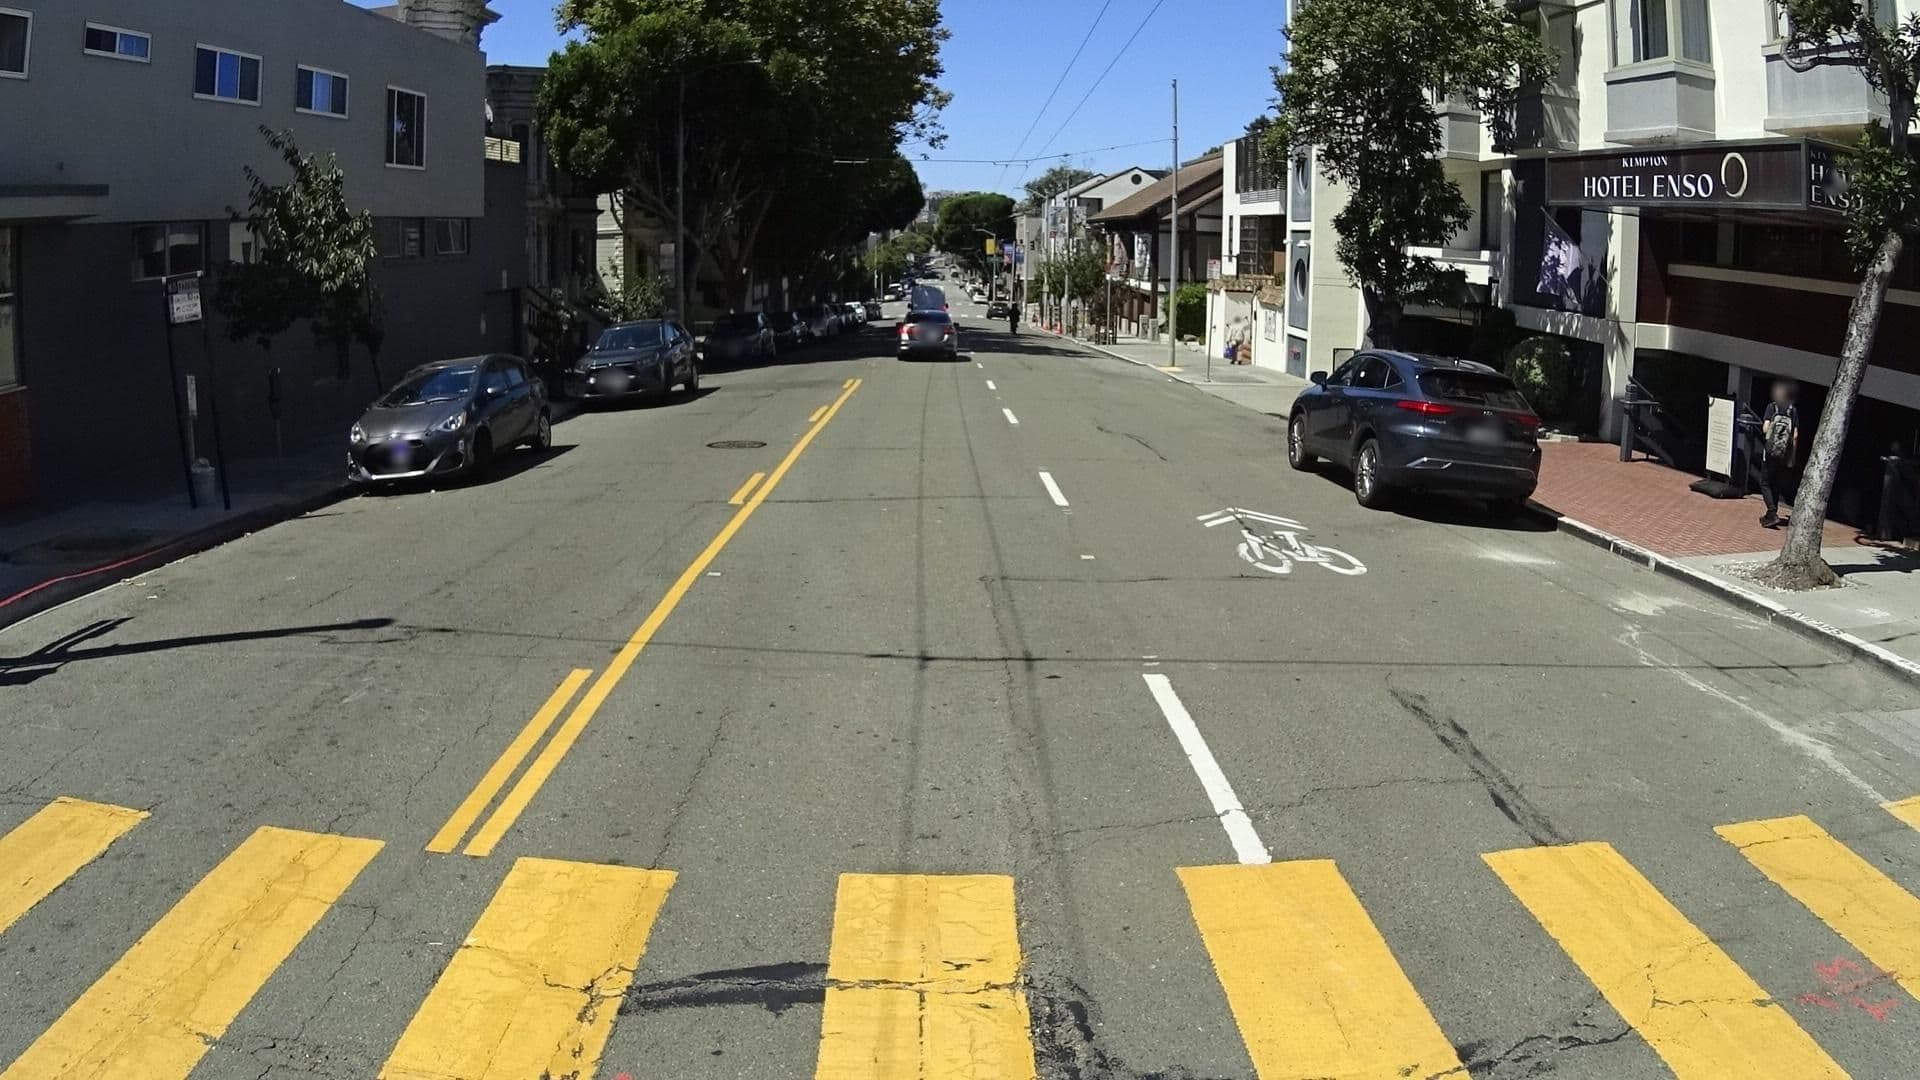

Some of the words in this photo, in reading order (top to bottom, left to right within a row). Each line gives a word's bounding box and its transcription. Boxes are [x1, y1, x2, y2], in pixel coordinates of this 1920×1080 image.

[1622, 156, 1668, 168] KIMPTON
[1584, 175, 1646, 198] HOTEL
[1653, 173, 1714, 198] ENSO
